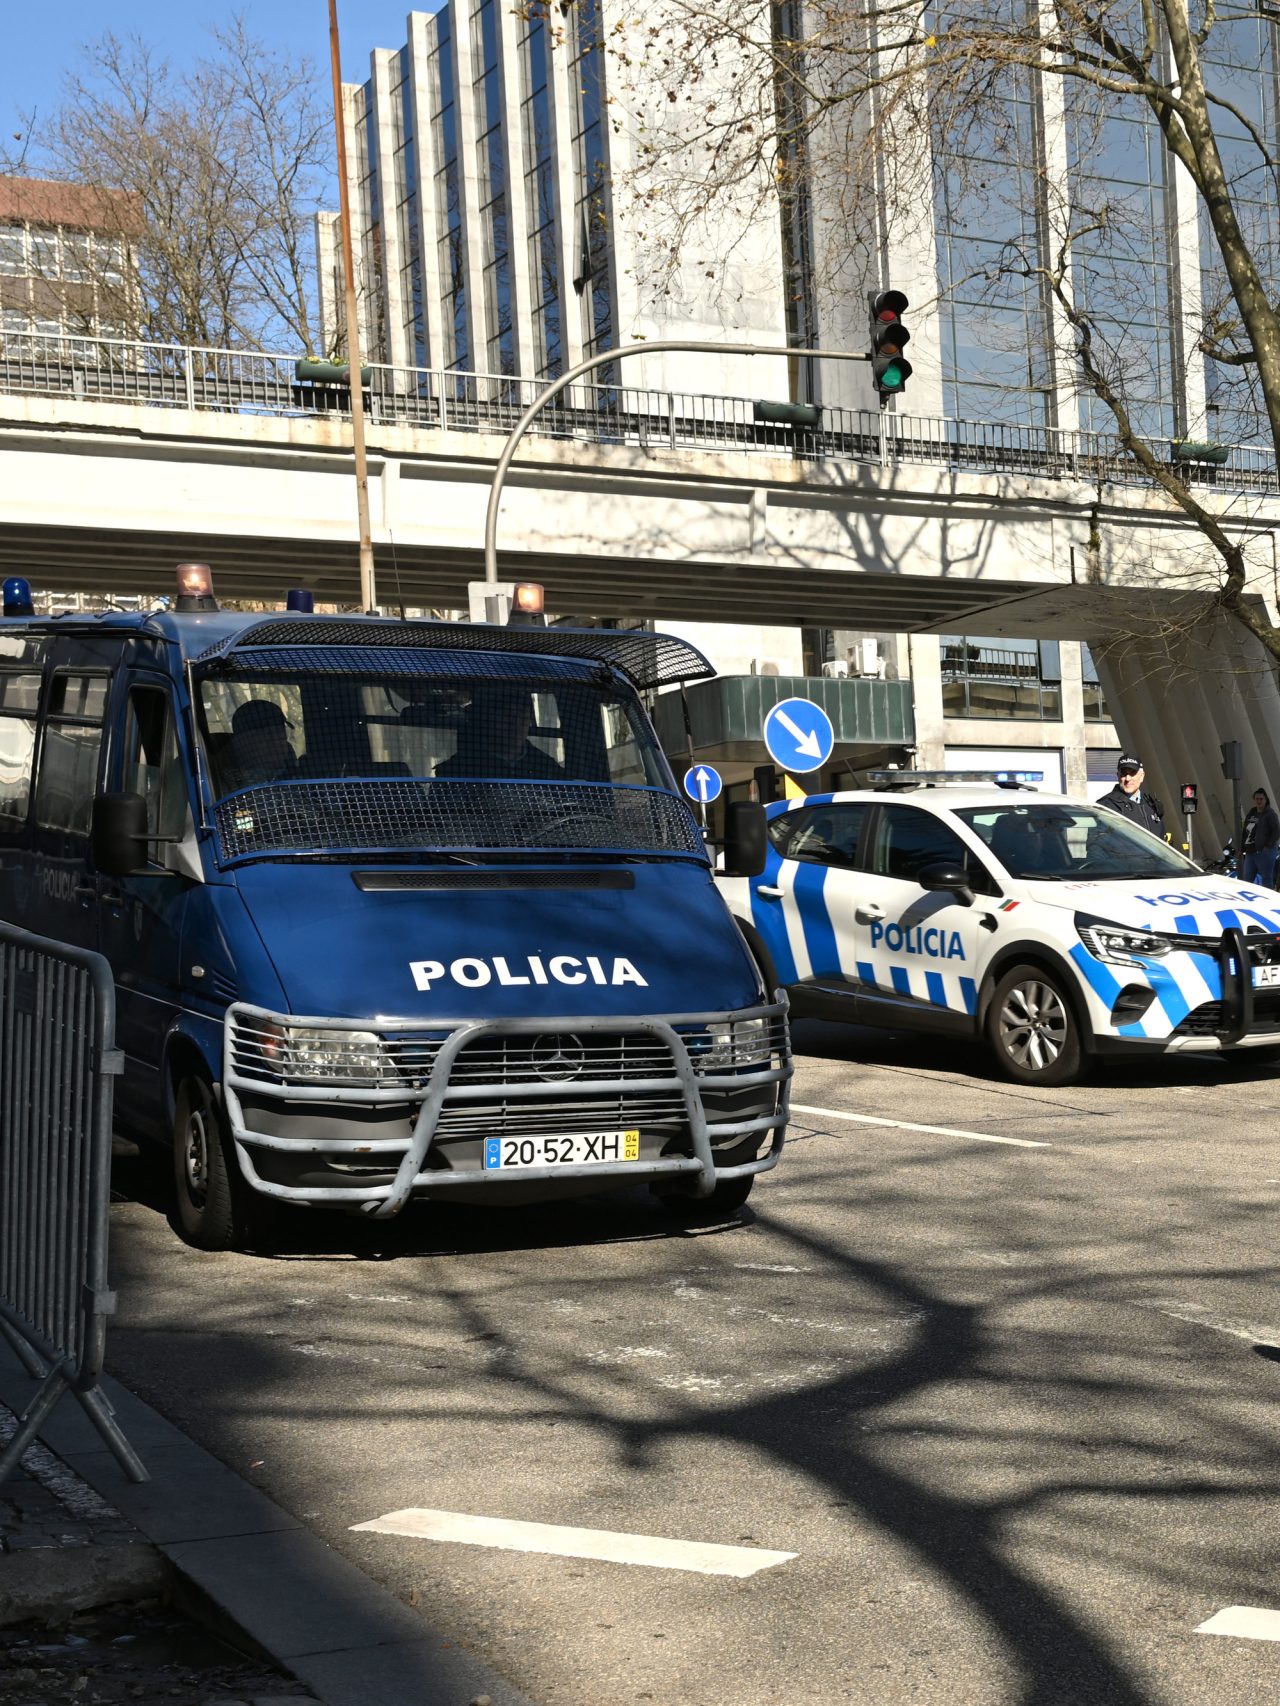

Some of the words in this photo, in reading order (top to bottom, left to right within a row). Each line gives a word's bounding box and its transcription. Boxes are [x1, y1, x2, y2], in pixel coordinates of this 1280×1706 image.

[625, 1134, 637, 1143] 04
[625, 1148, 637, 1158] 04
[490, 1156, 497, 1164] P
